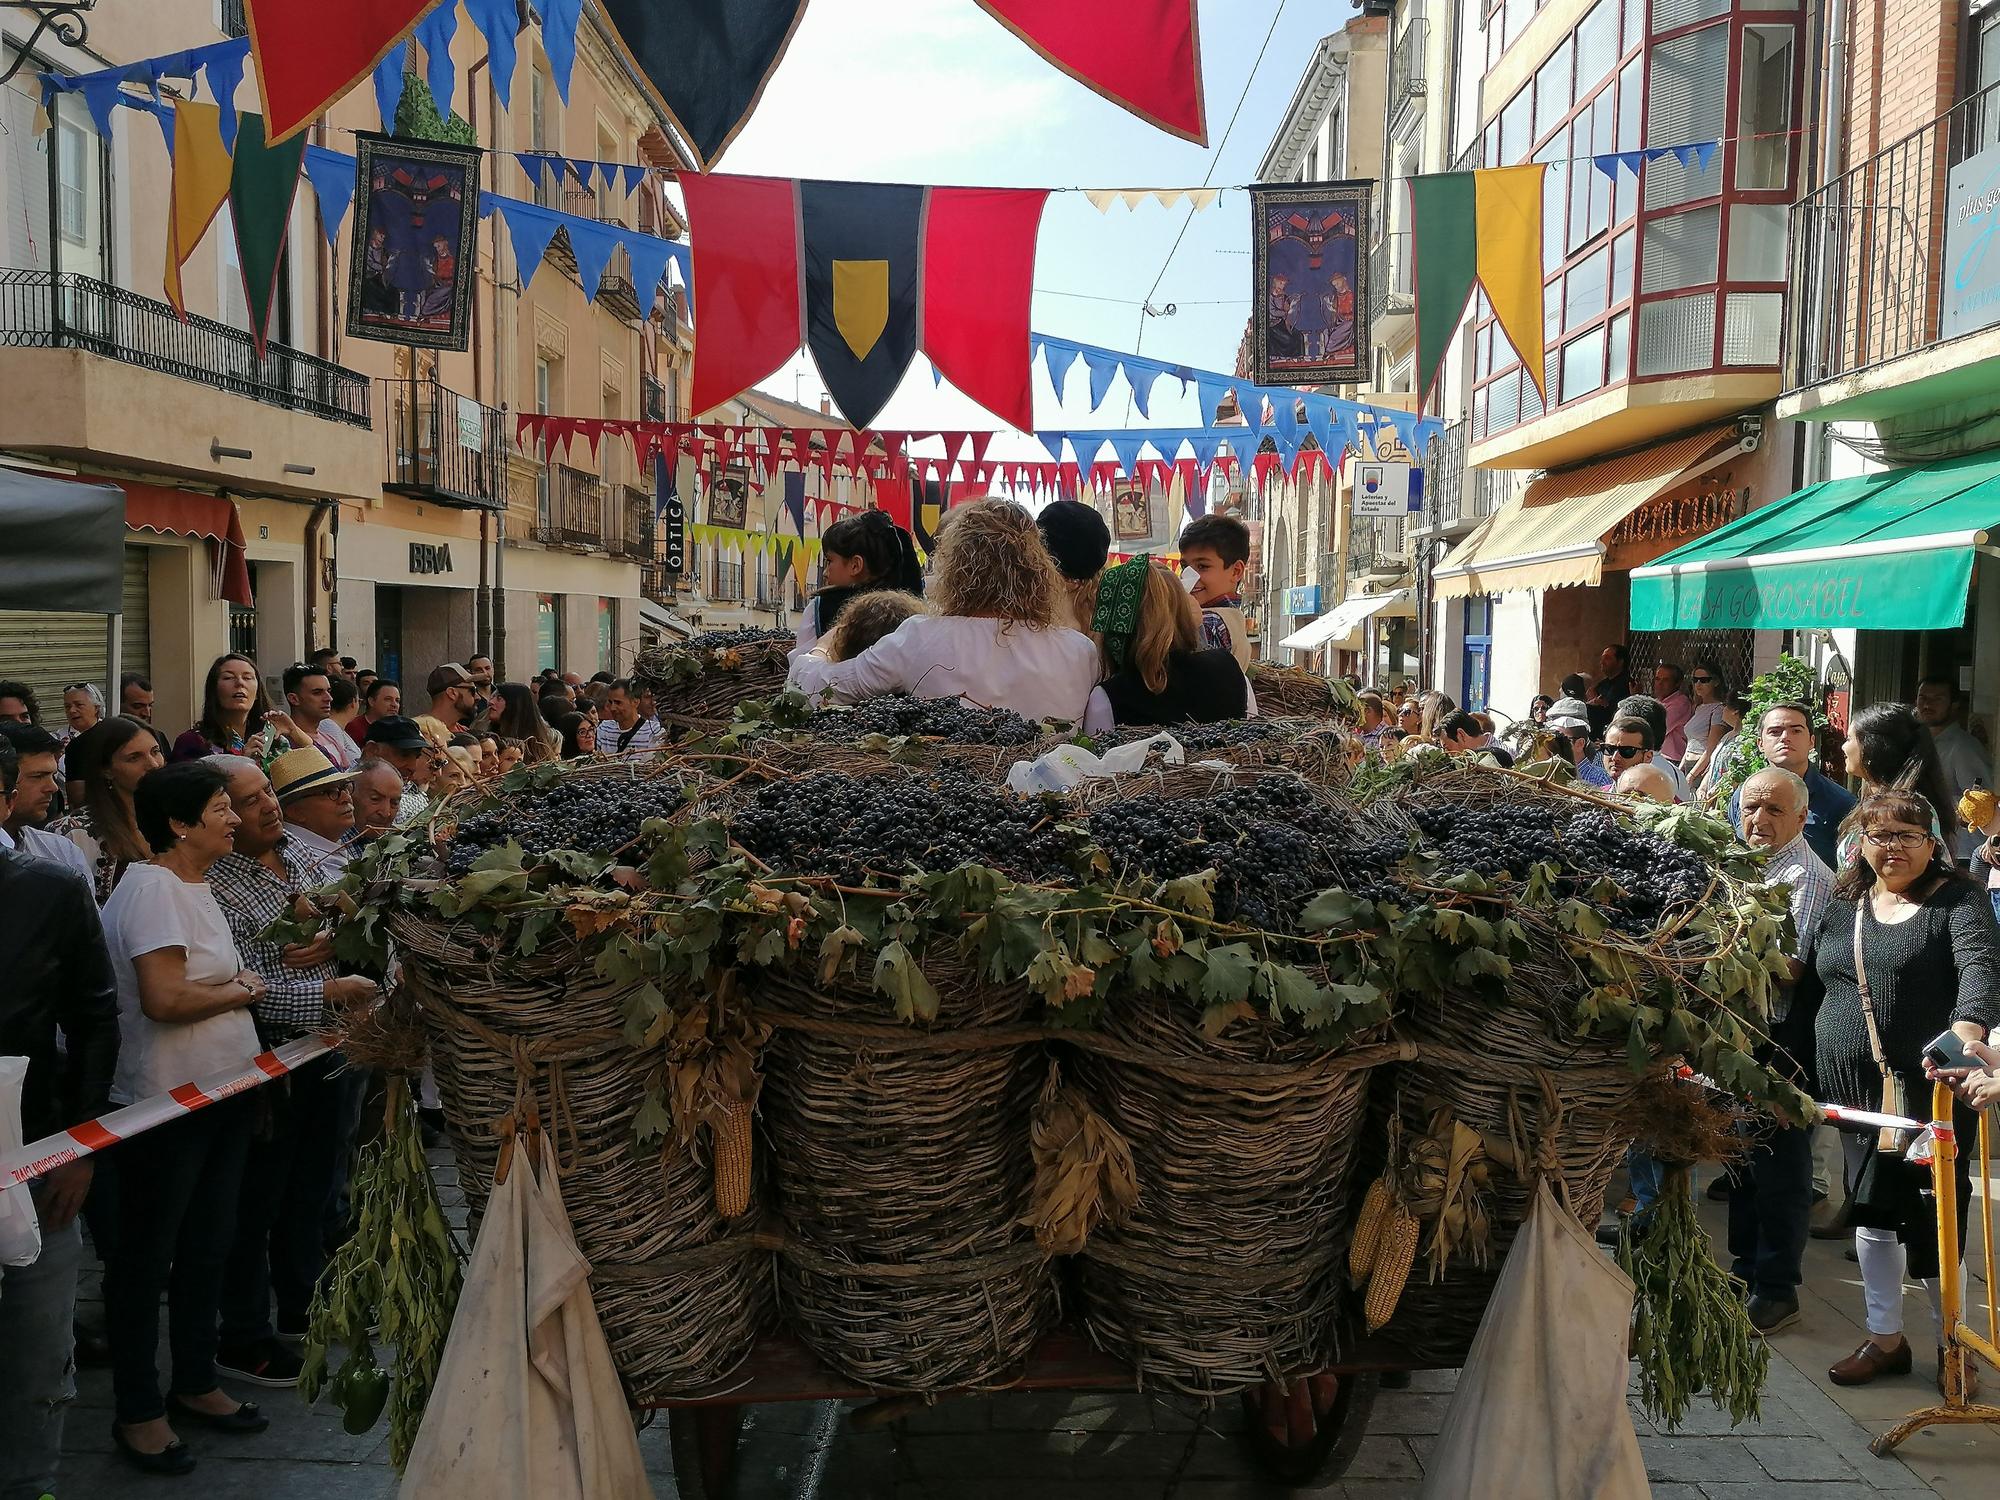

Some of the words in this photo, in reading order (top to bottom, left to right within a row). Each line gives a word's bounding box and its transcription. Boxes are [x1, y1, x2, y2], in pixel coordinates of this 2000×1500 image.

[1956, 192, 1984, 227] plus
[409, 542, 453, 574] BBVA
[1680, 586, 1725, 622] CASA
[1729, 575, 1866, 623] GOROSABEL
[11, 1166, 33, 1182] CIVIL
